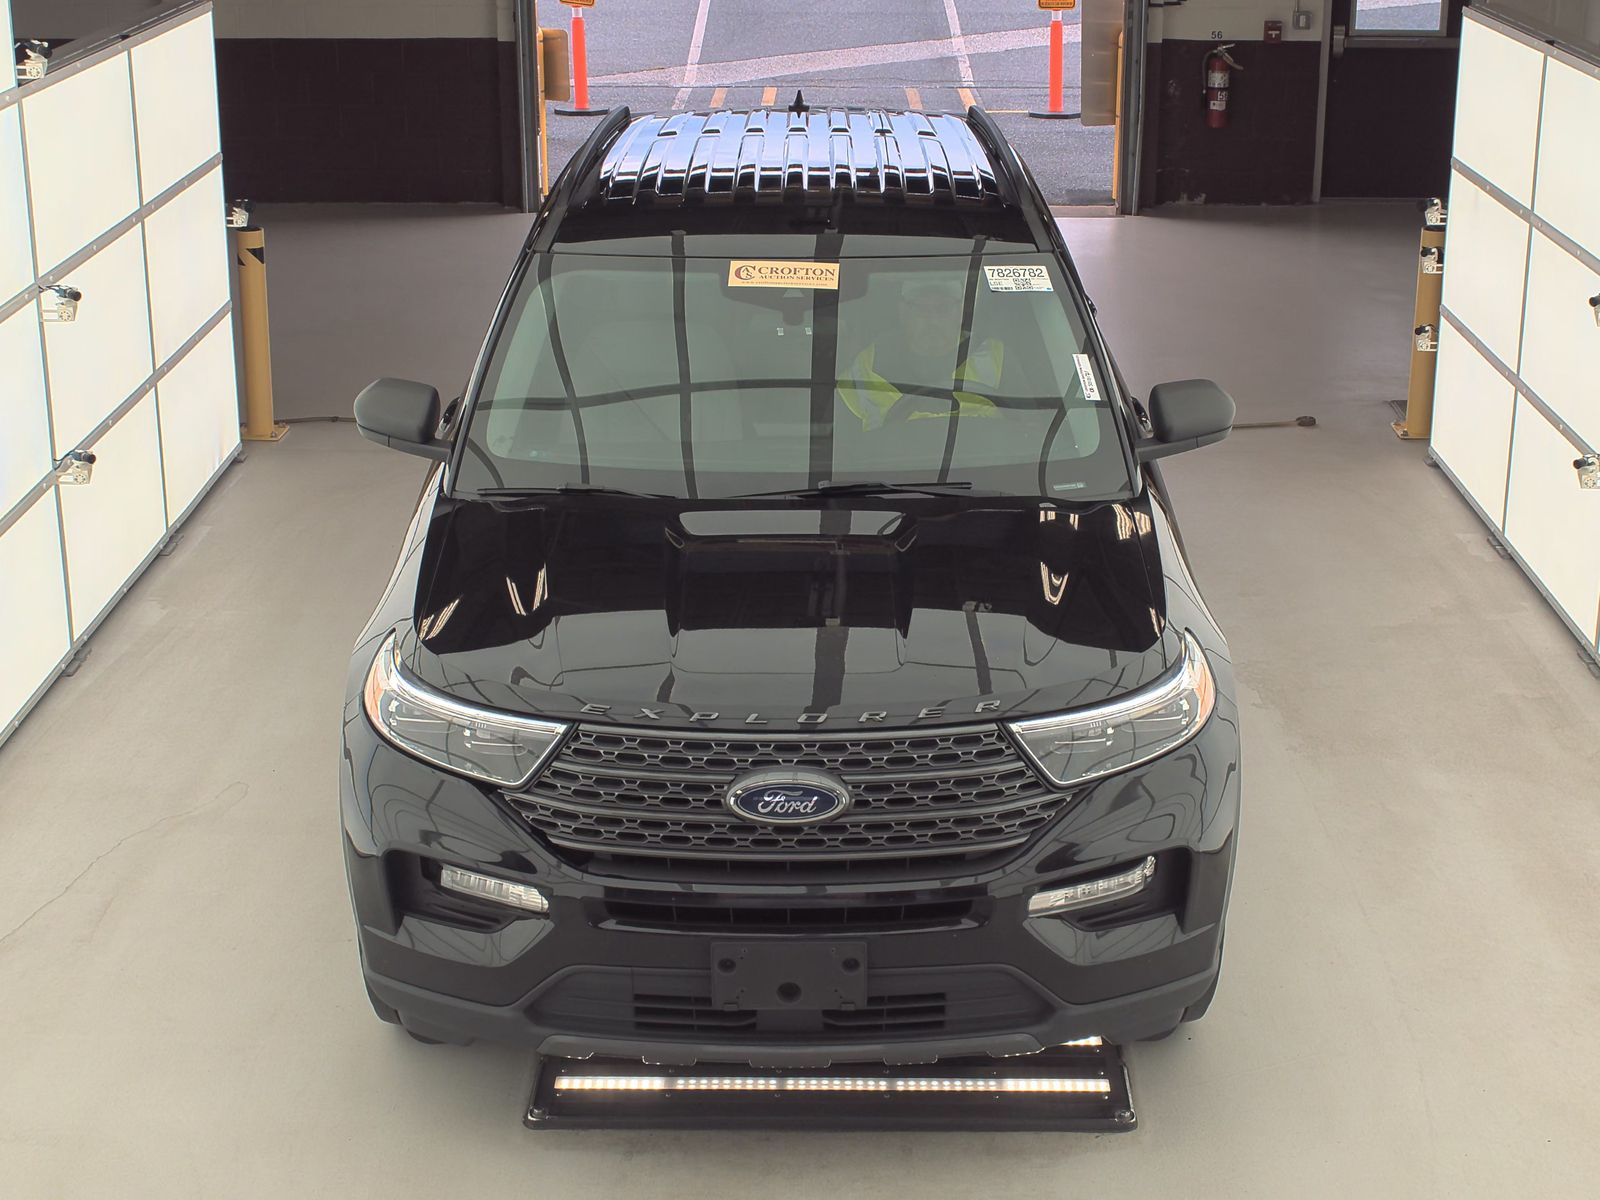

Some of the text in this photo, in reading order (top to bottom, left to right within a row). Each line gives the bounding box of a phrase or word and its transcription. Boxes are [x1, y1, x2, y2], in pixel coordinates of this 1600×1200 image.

[1211, 30, 1223, 39] 56
[757, 266, 836, 277] CROFTON
[987, 268, 1045, 278] 7826782
[580, 700, 1000, 725] EXPLORER
[757, 789, 818, 814] Ford
